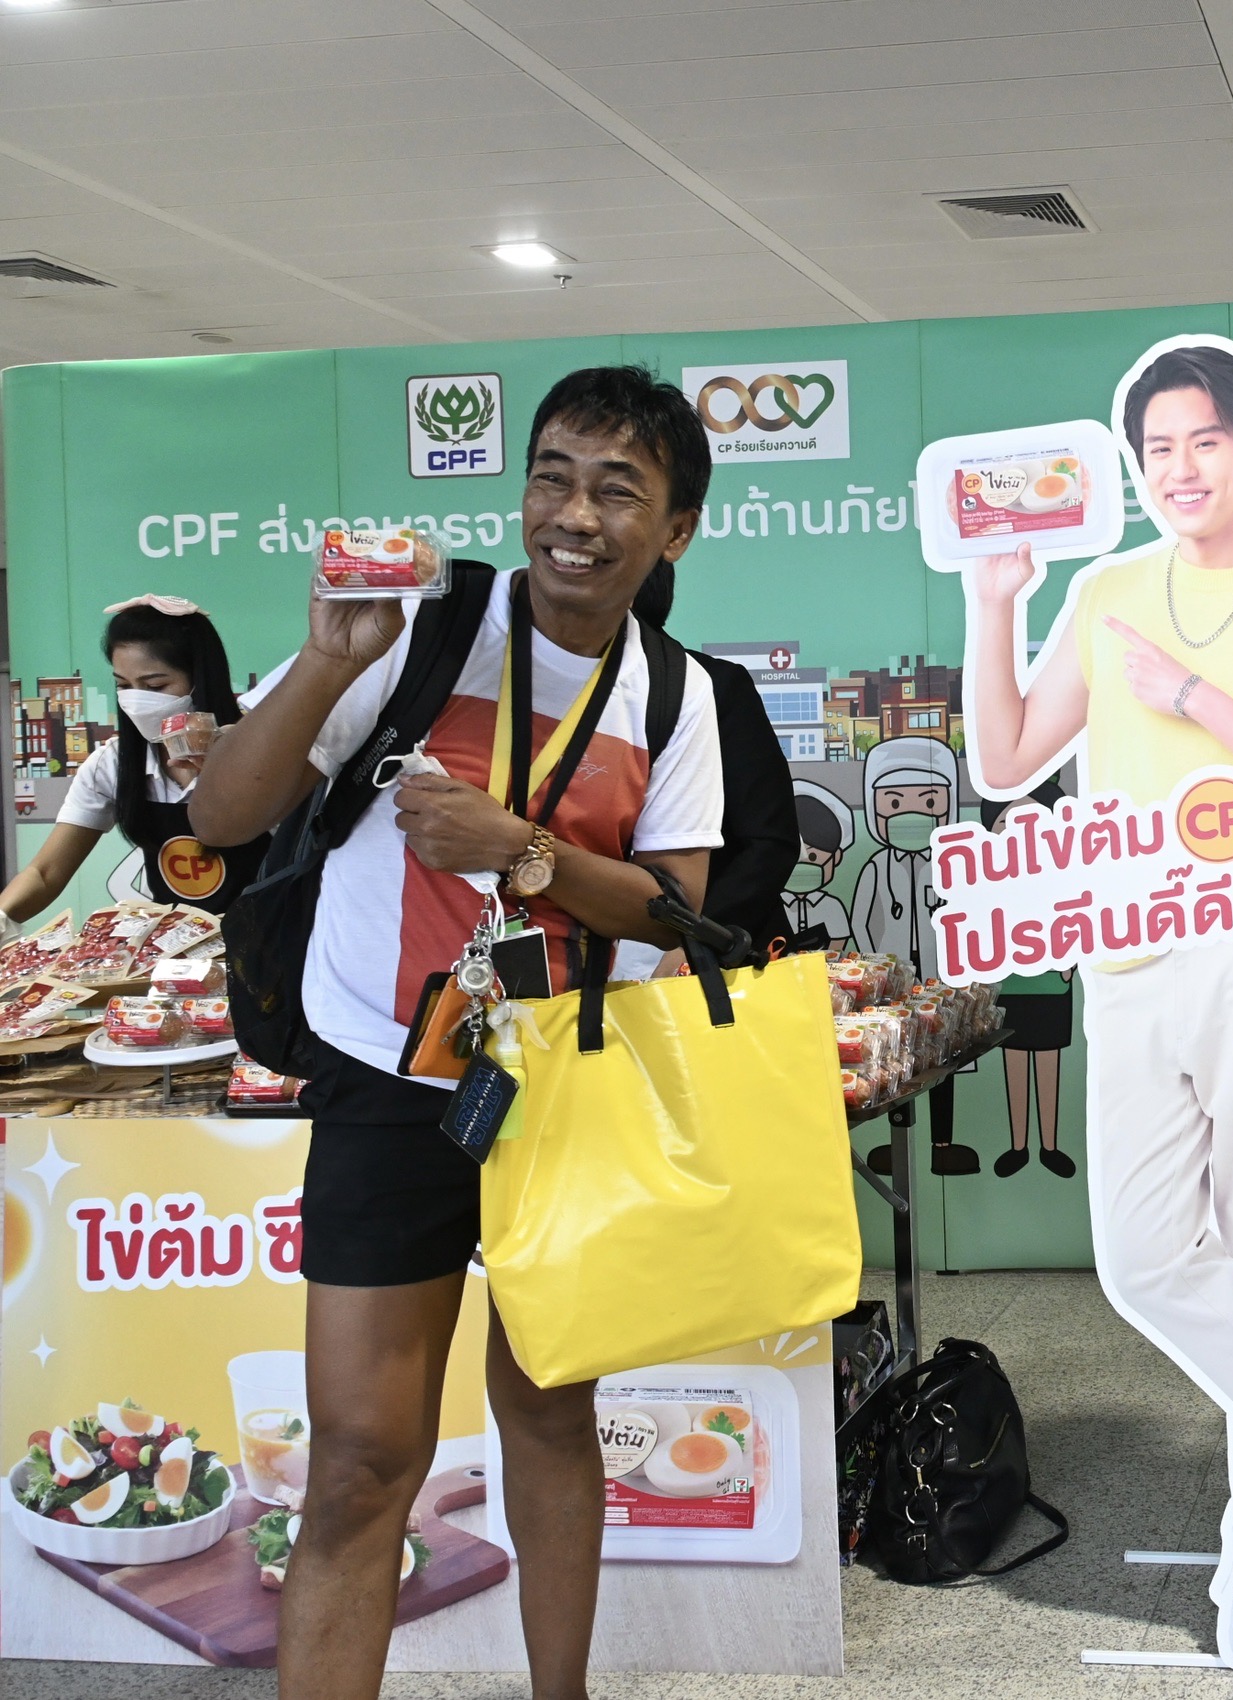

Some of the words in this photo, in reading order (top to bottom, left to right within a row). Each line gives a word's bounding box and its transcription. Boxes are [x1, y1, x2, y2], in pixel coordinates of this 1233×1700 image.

[717, 444, 732, 453] CP
[735, 437, 817, 453] ร้อยเรียงความดี
[428, 449, 487, 471] CPF
[965, 479, 979, 488] CP
[138, 512, 239, 558] CPF
[761, 672, 800, 681] HOSPITAL
[938, 798, 1164, 890] กินไข่ต้ม
[168, 854, 214, 881] CP
[940, 864, 1233, 976] โปรตีนดี๊ดี
[482, 1083, 491, 1097] RISE
[478, 1099, 484, 1108] OF
[462, 1109, 479, 1145] SKYWALKER
[76, 1202, 243, 1281] ไข่ต้ม
[599, 1419, 645, 1448] ข่ต้ม
[716, 1478, 731, 1488] Only
